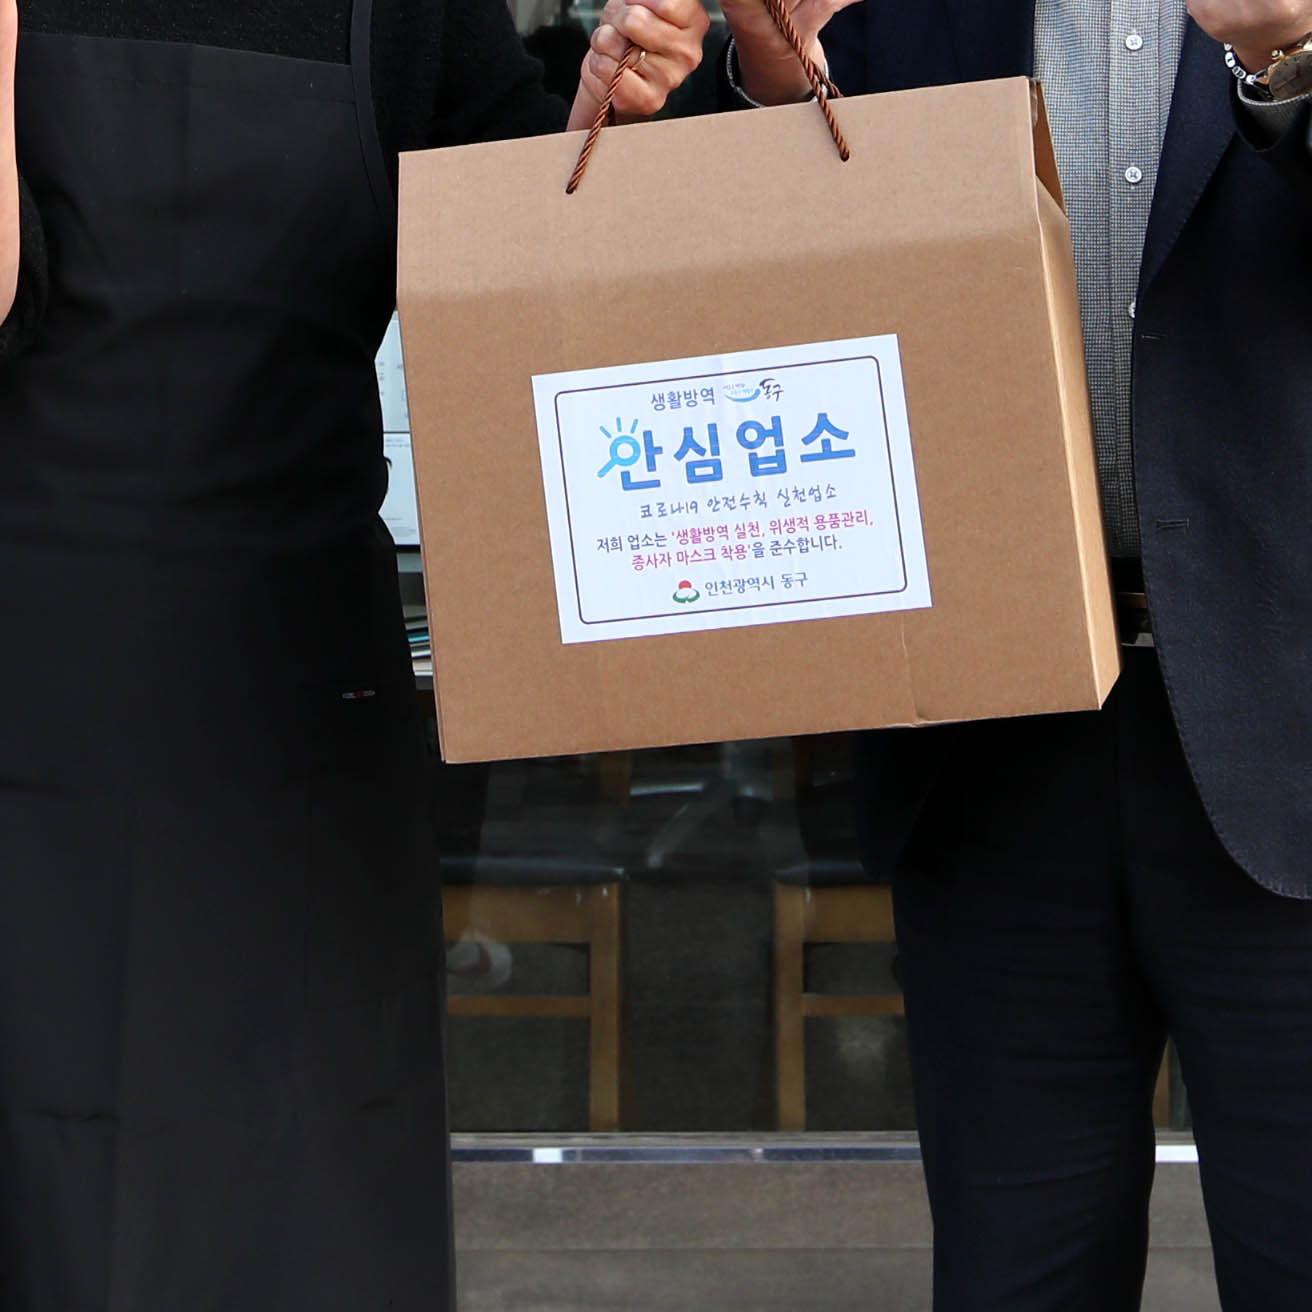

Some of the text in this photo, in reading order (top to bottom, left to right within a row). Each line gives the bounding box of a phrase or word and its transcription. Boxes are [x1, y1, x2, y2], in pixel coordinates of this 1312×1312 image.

[650, 386, 717, 412] 생활방역
[596, 412, 856, 492] 안심업소
[706, 492, 769, 515] 안전수칙
[776, 483, 838, 507] 실천업소
[595, 535, 624, 553] 저희
[626, 531, 668, 550] 업소는
[733, 522, 766, 541] 실천,
[768, 515, 812, 537] 위생적
[812, 508, 875, 532] 용품관리,
[631, 552, 673, 571] 종사자
[675, 547, 718, 568] 마스크
[768, 533, 844, 558] 준수합니다.
[704, 571, 810, 598] 인천광역시 동구
